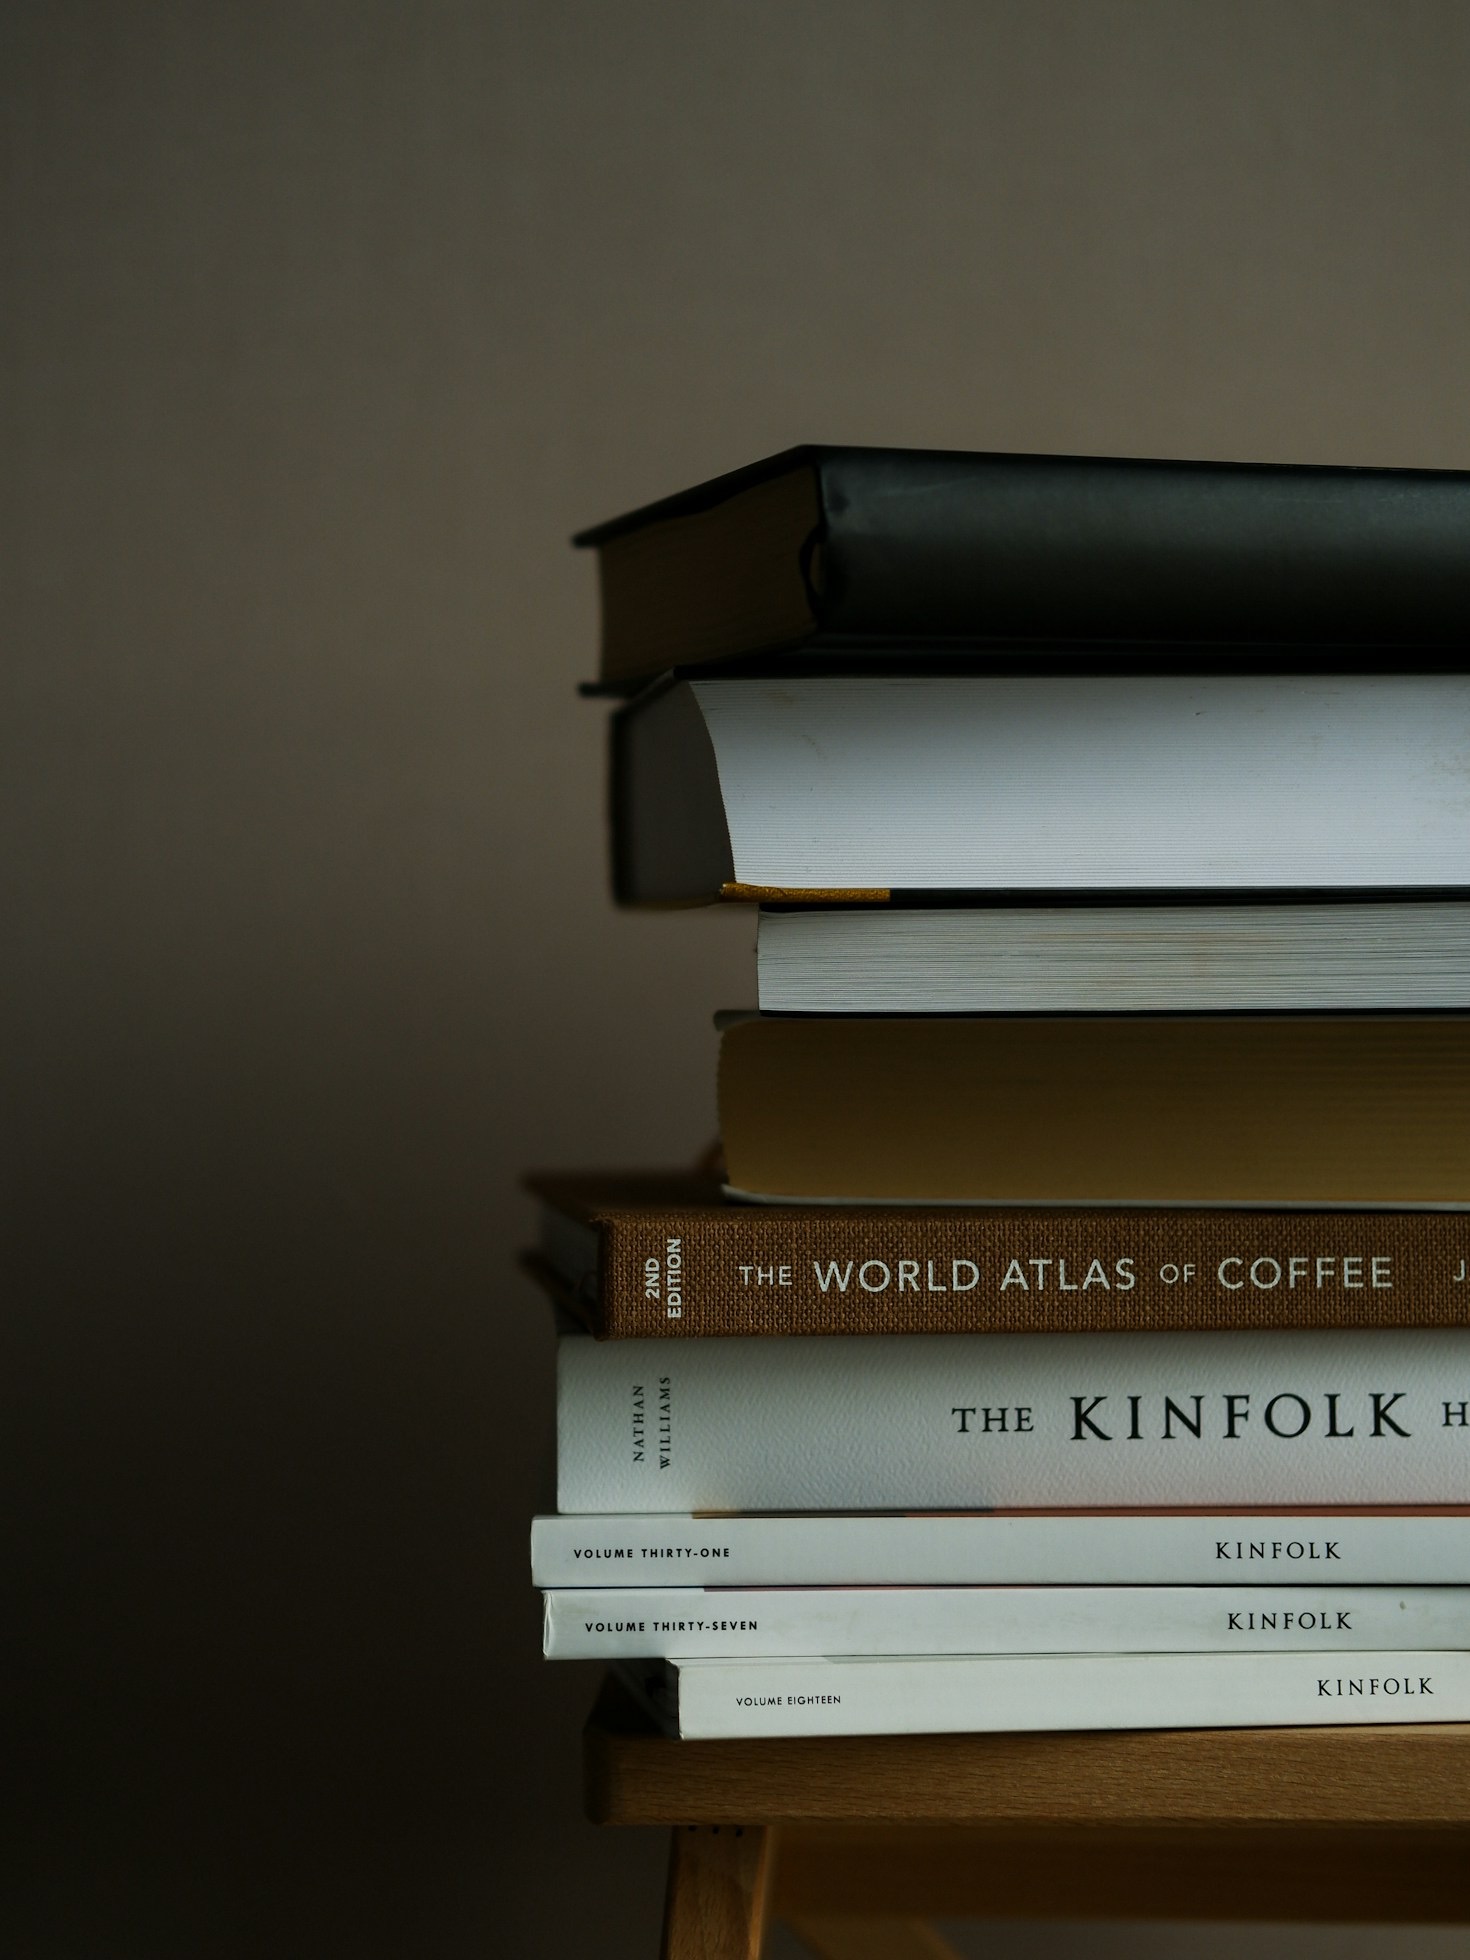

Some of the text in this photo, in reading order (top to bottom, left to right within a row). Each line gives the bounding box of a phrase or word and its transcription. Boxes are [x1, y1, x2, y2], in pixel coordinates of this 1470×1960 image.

[645, 1257, 660, 1299] 2ND
[666, 1237, 682, 1319] EDITION
[738, 1257, 1394, 1293] THE WORLD ATLAS OF COFFEE
[632, 1384, 645, 1463] NATHAN
[659, 1375, 671, 1470] WILLIAMS
[951, 1407, 1035, 1434] THE
[1069, 1392, 1413, 1441] KINFOLK
[573, 1547, 731, 1559] VOLUME THIRTY-ONE
[1214, 1541, 1342, 1560] KINFOLK
[584, 1620, 759, 1633] VOLUME THIRTY-SEVEN
[1227, 1612, 1353, 1631] KINFOLK
[735, 1695, 842, 1707] VOLUME EIGHTEEN
[1316, 1677, 1435, 1697] KINFOLK
